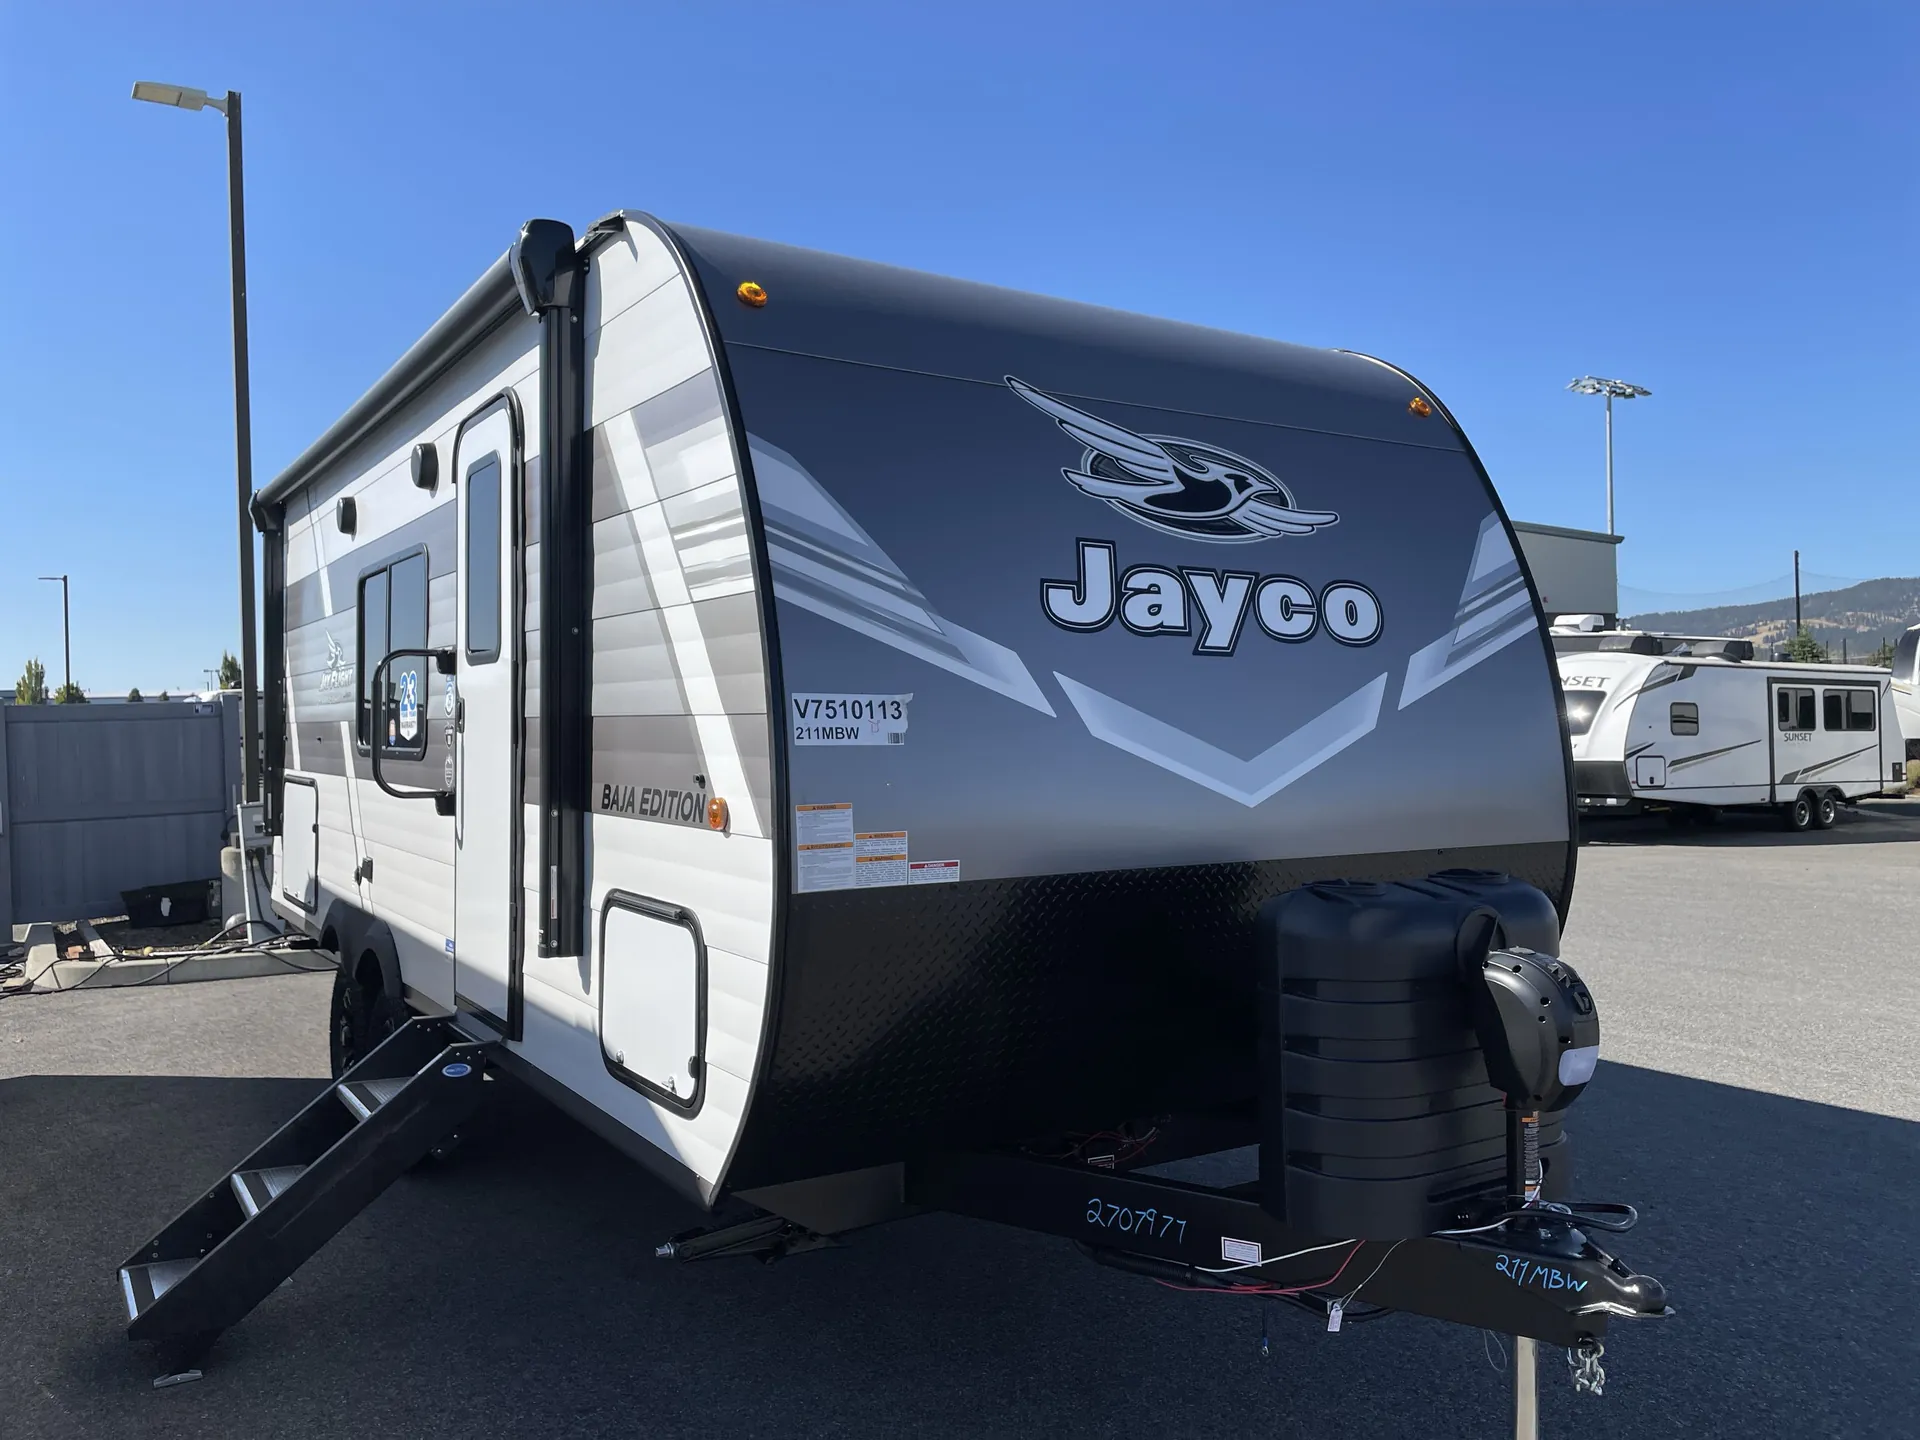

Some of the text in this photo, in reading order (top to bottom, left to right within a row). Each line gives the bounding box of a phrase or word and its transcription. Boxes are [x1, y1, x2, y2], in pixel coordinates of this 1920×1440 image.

[1040, 537, 1384, 657] Jayco
[1560, 675, 1611, 688] NSET
[793, 698, 903, 720] V7510113
[795, 726, 860, 740] 211MBW
[1784, 732, 1812, 742] SUNSET
[601, 783, 706, 823] BAJA EDITION
